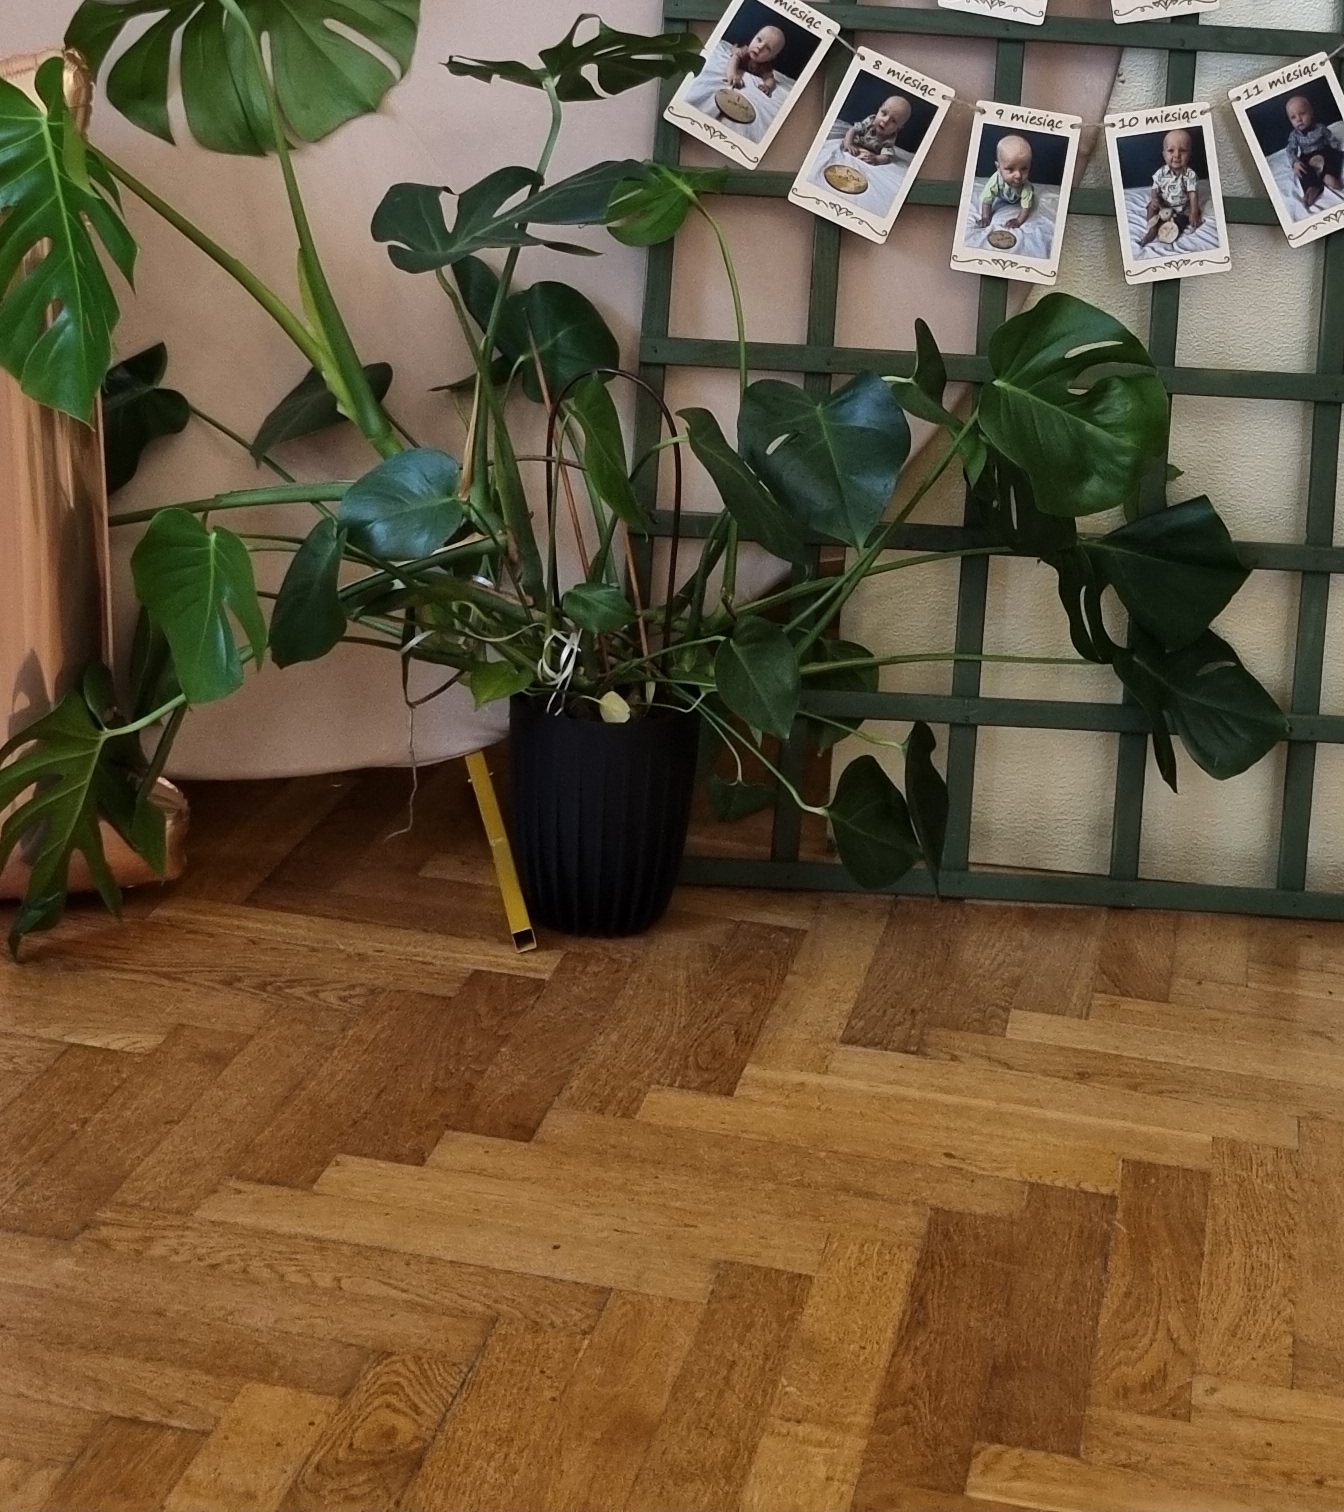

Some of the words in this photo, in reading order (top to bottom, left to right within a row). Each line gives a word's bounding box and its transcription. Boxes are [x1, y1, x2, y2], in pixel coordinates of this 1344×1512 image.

[873, 60, 882, 71] 8
[886, 66, 937, 98] miesiąc
[1242, 84, 1263, 102] 11
[1268, 61, 1319, 92] miesiąc
[996, 108, 1005, 119] 9
[1010, 112, 1064, 132] miesiąc
[1118, 116, 1140, 129] 10
[1145, 108, 1198, 126] miesiąc
